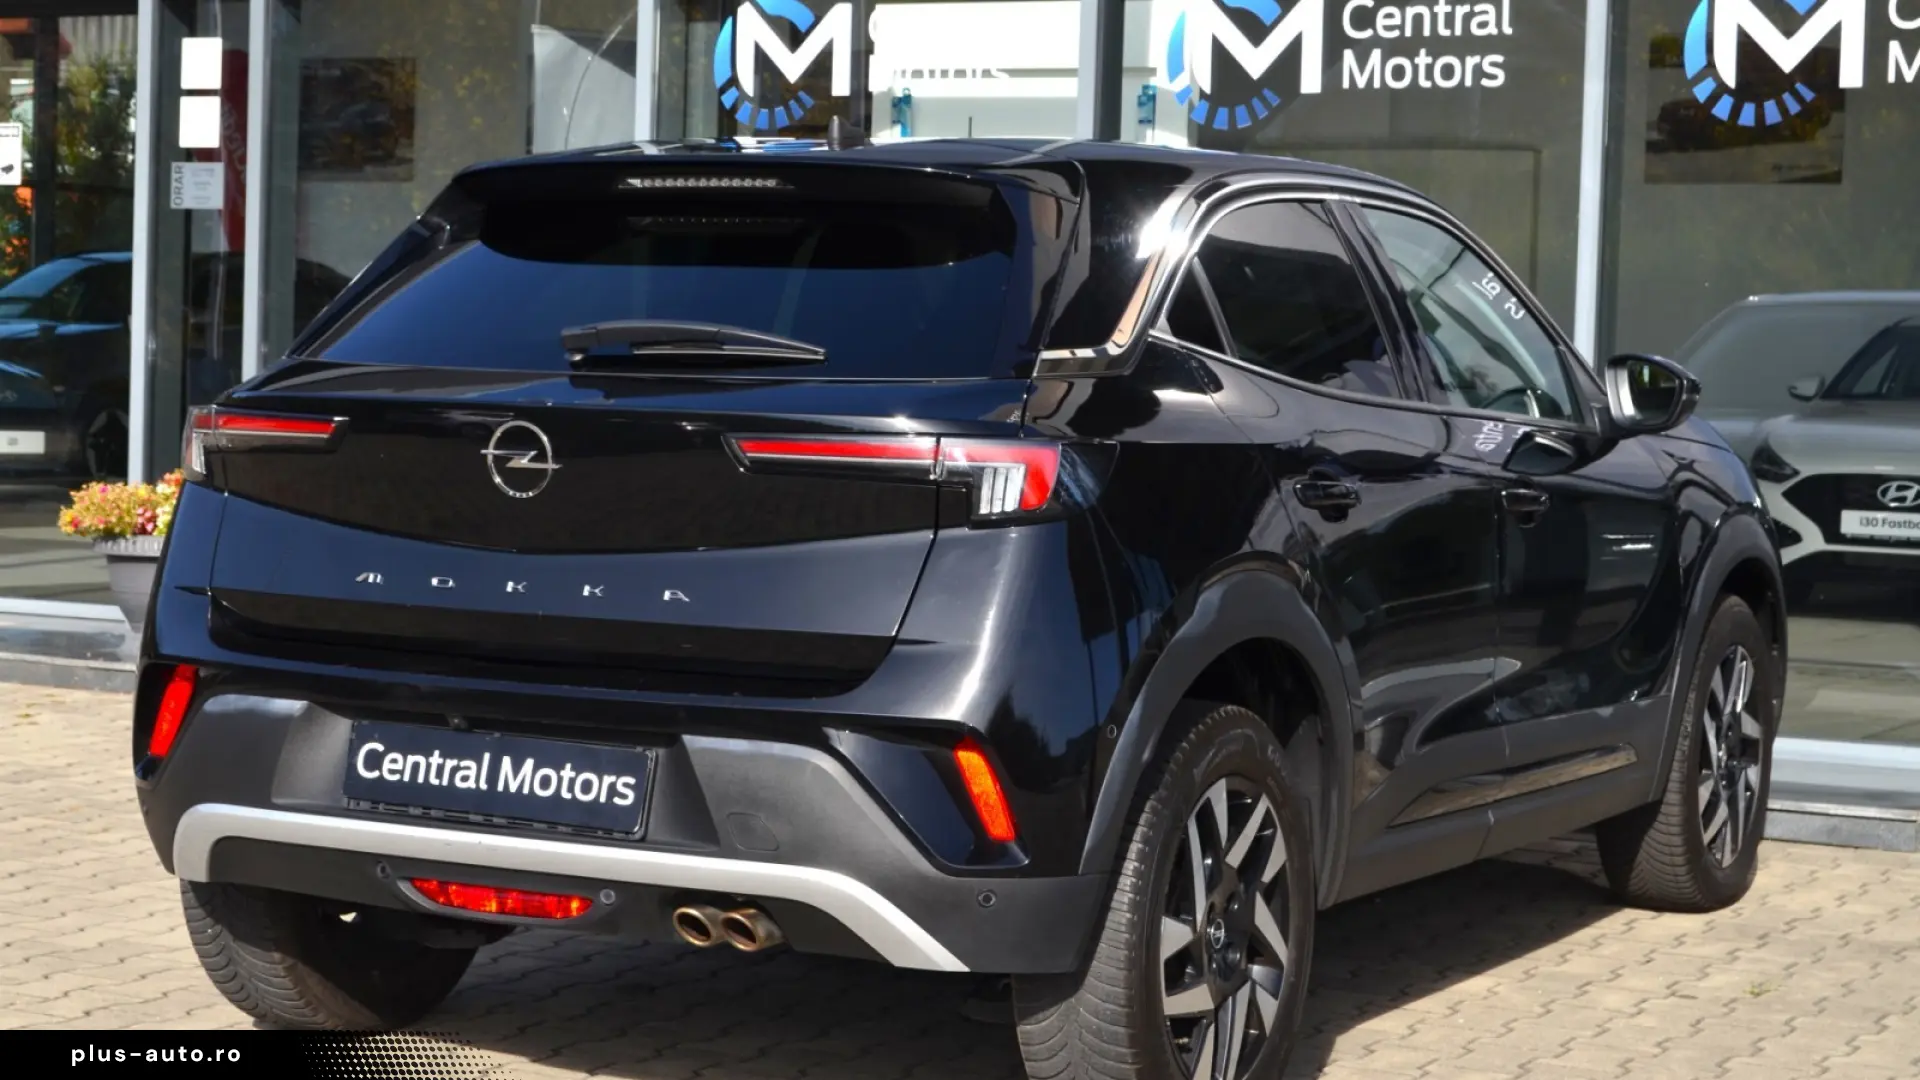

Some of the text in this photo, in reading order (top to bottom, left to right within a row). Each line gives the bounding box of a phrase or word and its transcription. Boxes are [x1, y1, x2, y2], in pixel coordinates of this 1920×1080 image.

[1342, 0, 1513, 39] Central
[1342, 48, 1507, 90] Motors
[173, 164, 185, 206] ORAR
[355, 571, 690, 602] MOKKA
[356, 742, 637, 806] Central Motors
